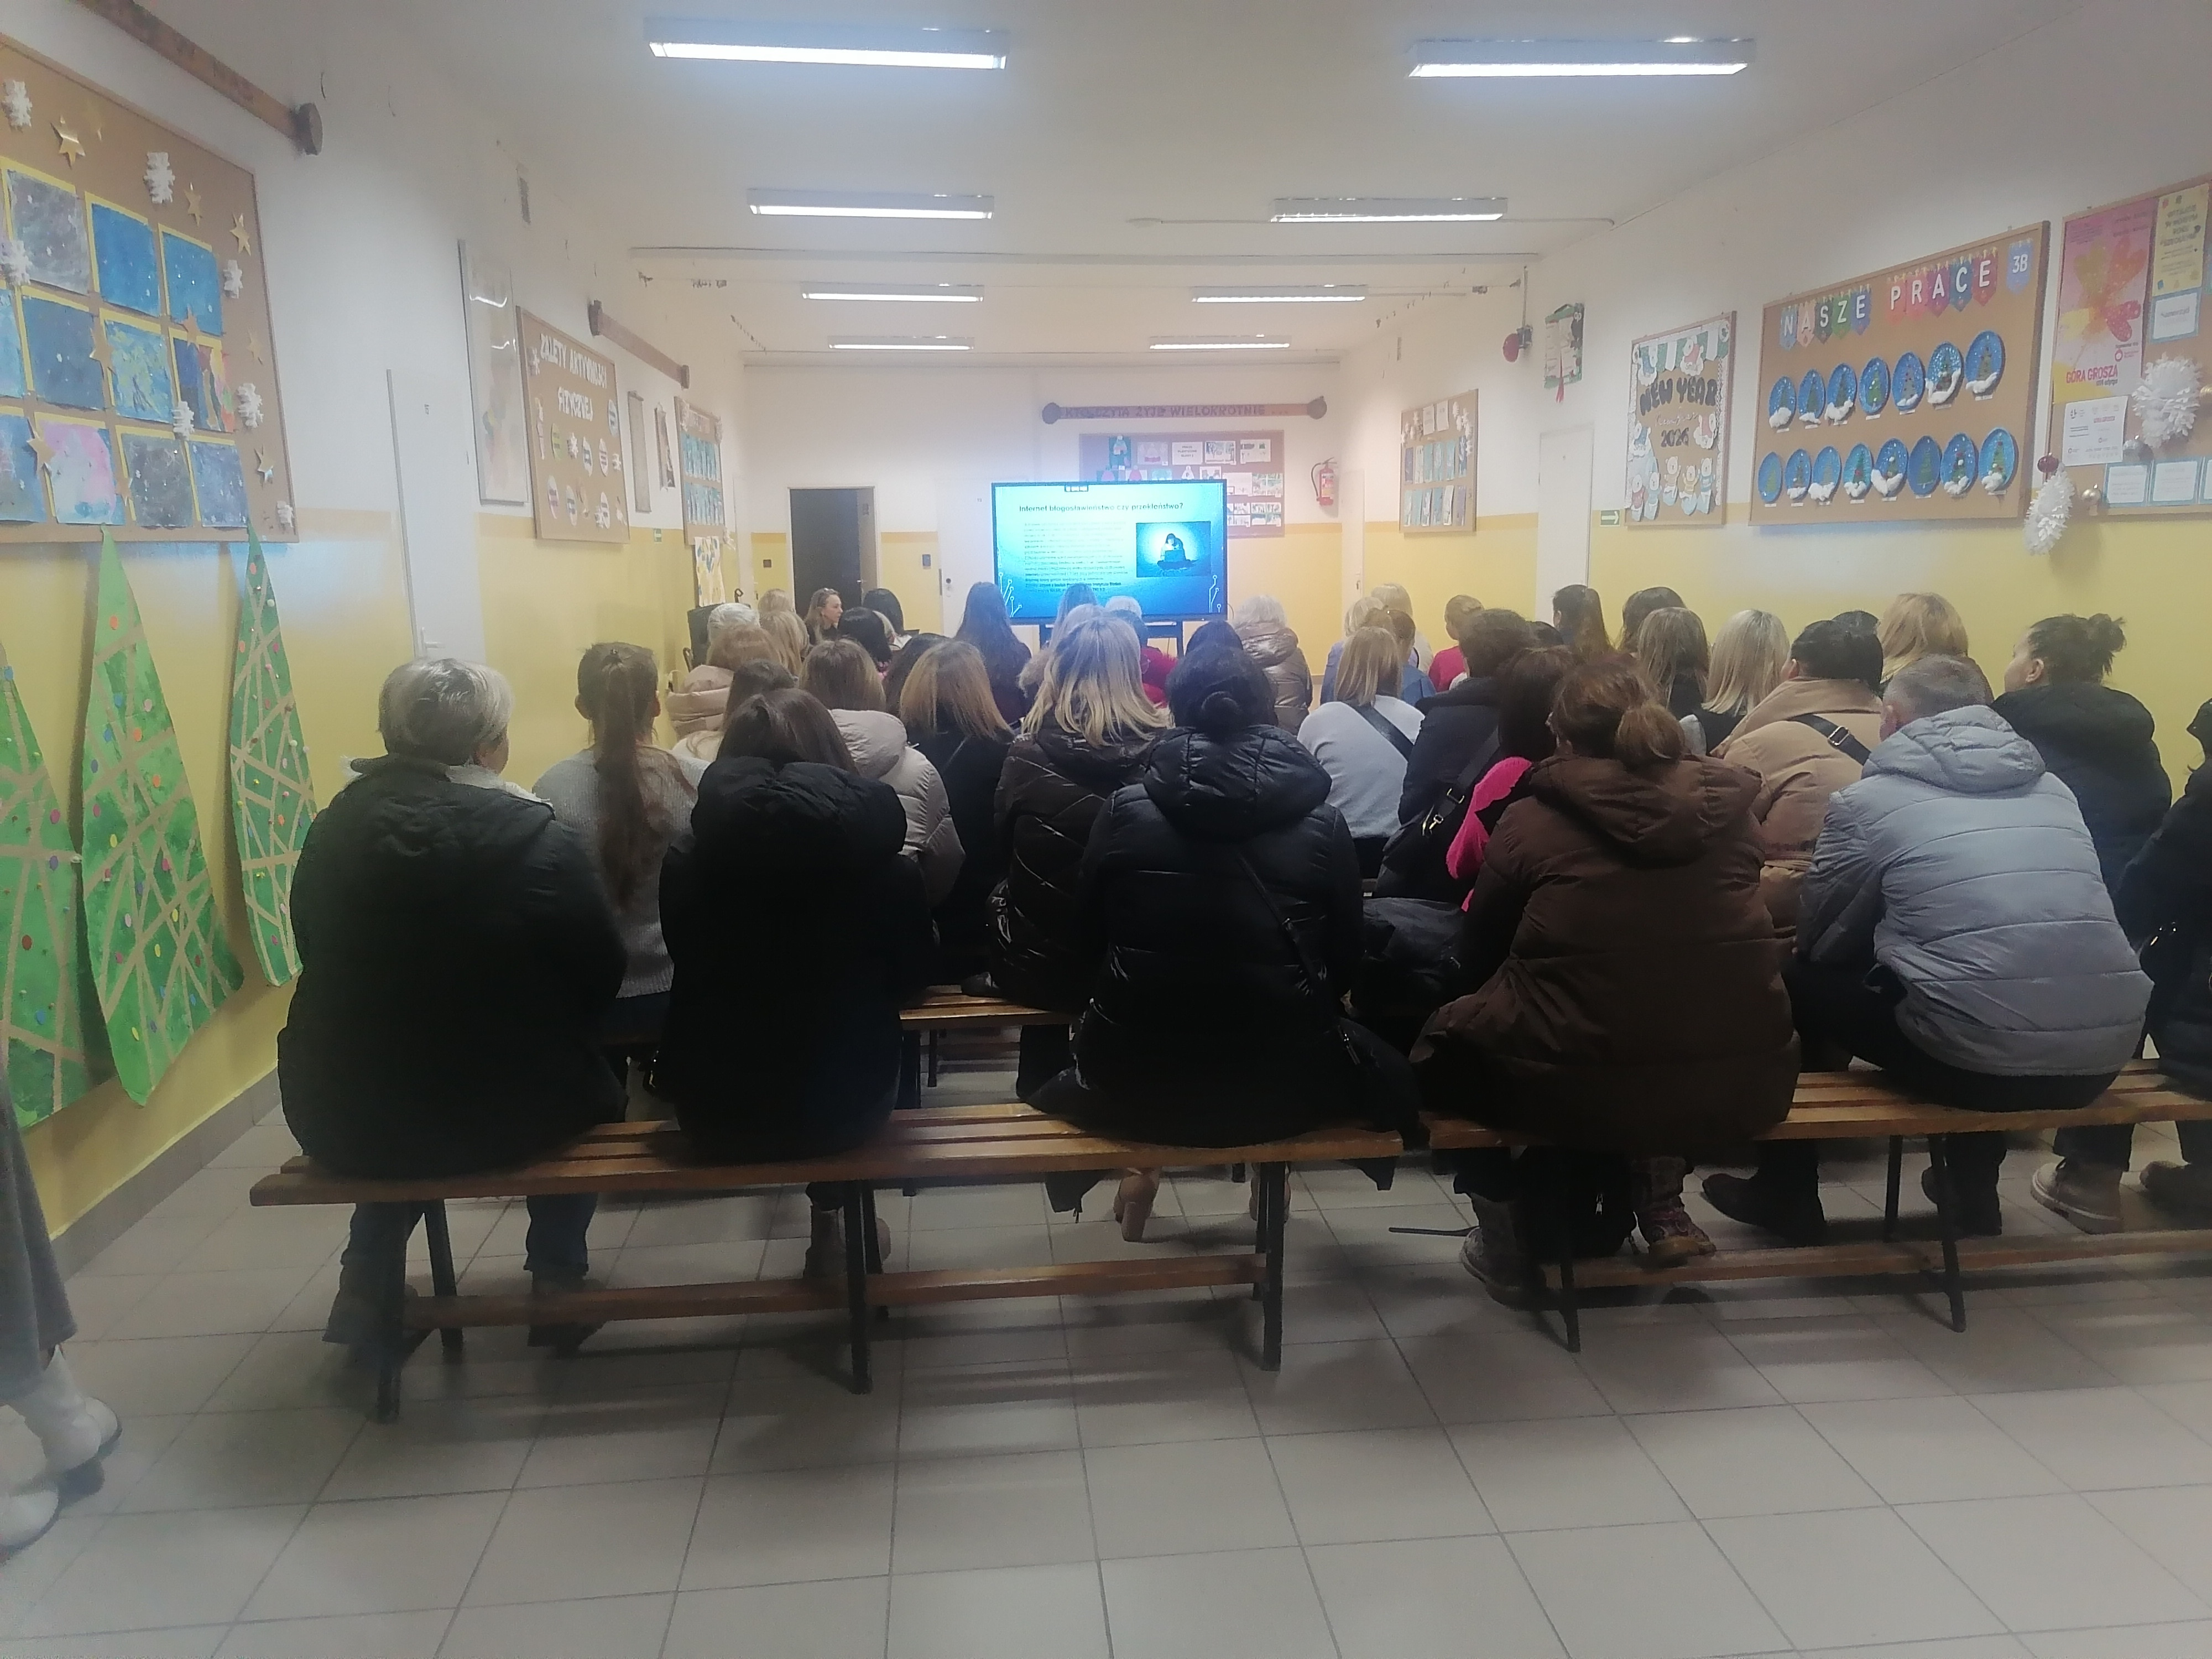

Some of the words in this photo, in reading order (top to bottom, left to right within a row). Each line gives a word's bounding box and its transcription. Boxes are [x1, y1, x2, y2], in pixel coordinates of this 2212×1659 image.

[1783, 295, 1866, 336] NASZE
[1890, 260, 1991, 310] PRACE
[2012, 254, 2028, 273] 3B
[540, 333, 566, 369] ZALETY
[2066, 368, 2086, 383] GÓRA
[2088, 364, 2117, 380] GROSZA
[1170, 404, 1265, 417] WIELOKROTNIE
[1640, 378, 1673, 416] NEW
[1676, 377, 1717, 406] YEAR
[1661, 427, 1689, 447] 2026
